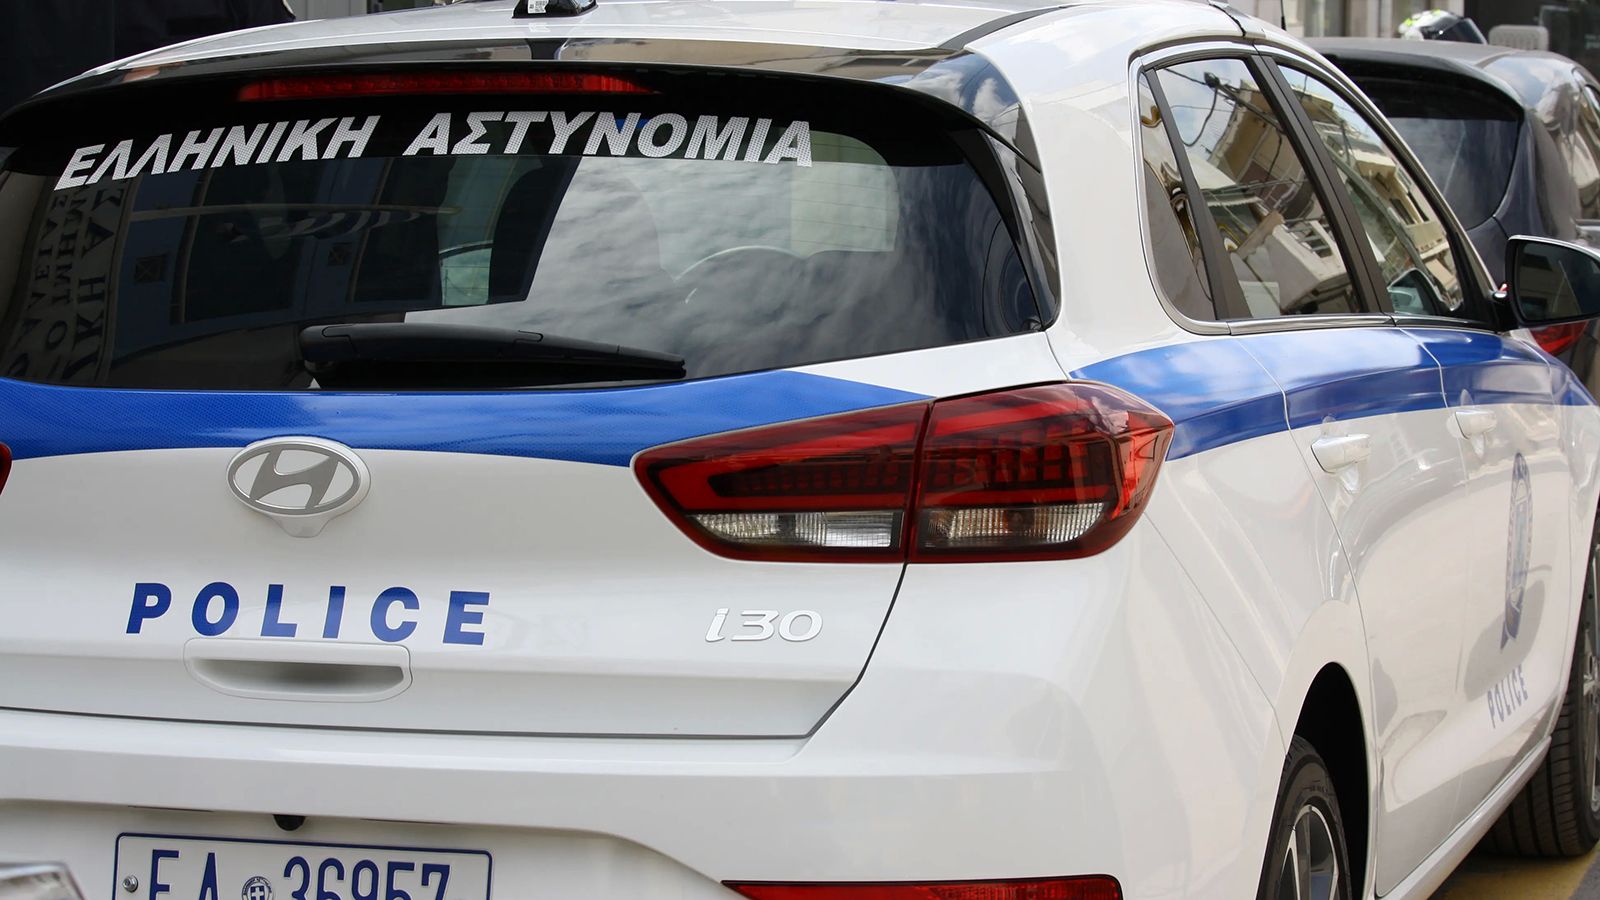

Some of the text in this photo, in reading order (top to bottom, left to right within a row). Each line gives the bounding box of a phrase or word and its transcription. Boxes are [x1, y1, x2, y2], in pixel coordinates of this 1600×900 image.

[53, 111, 814, 191] ΕΛΛΗΝΙΚΗ ΑΣΤΥΝΟΜΙΑ
[126, 581, 491, 646] POLICE
[705, 608, 823, 643] i30
[1487, 663, 1529, 730] POLICE
